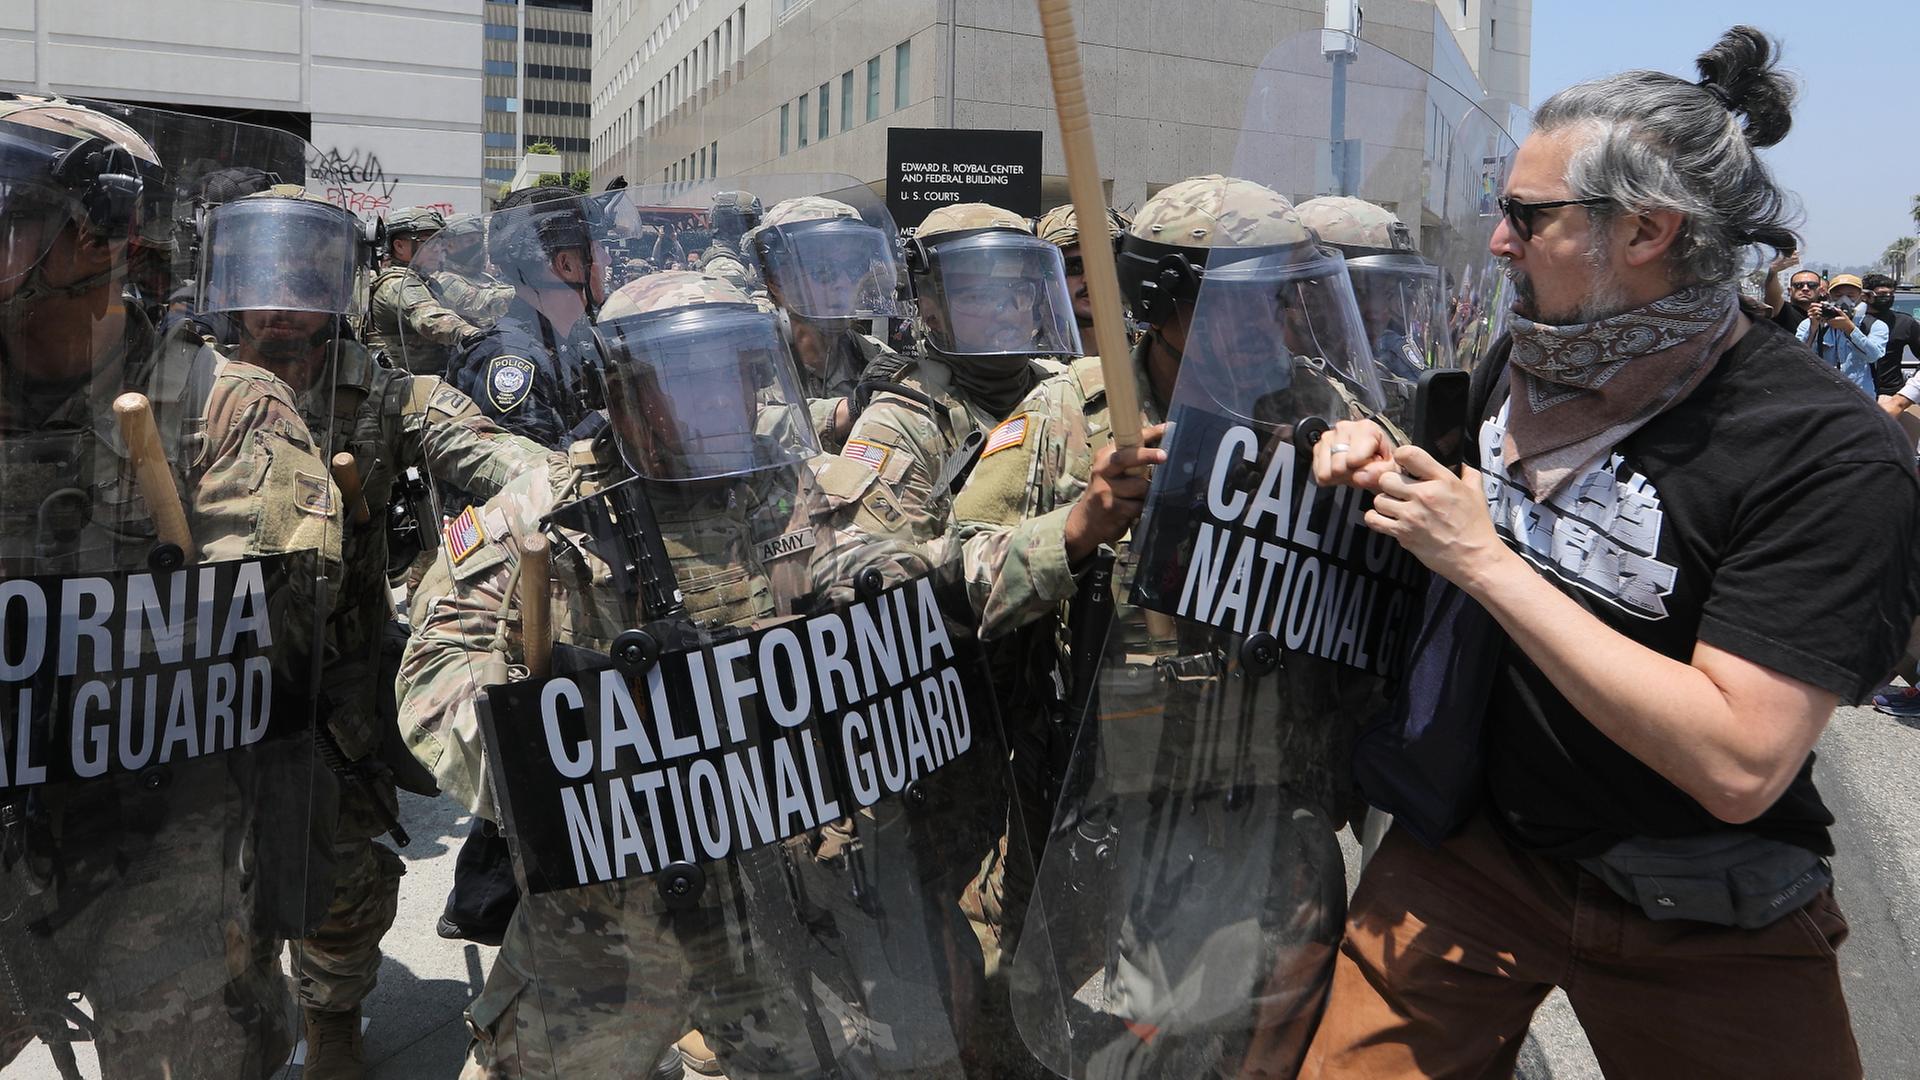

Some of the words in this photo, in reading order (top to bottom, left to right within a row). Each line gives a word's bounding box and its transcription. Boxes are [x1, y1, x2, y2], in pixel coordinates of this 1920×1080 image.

[901, 163, 940, 172] EDWARD
[942, 163, 950, 173] R.
[953, 164, 989, 174] ROYBAL
[990, 164, 1024, 174] CENTER
[901, 174, 923, 183] AND
[925, 174, 964, 184] FEDERAL
[966, 175, 1009, 185] BUILDING
[900, 191, 909, 200] U.
[912, 191, 921, 201] S.
[923, 191, 960, 201] COURTS
[495, 359, 531, 373] POLICE
[764, 533, 803, 559] ARMY
[1177, 521, 1378, 670] NATIONAL
[540, 576, 955, 779] CALIFORNIA
[71, 655, 272, 778] GUARD
[560, 729, 841, 885] NATIONAL
[842, 666, 972, 807] GUARD
